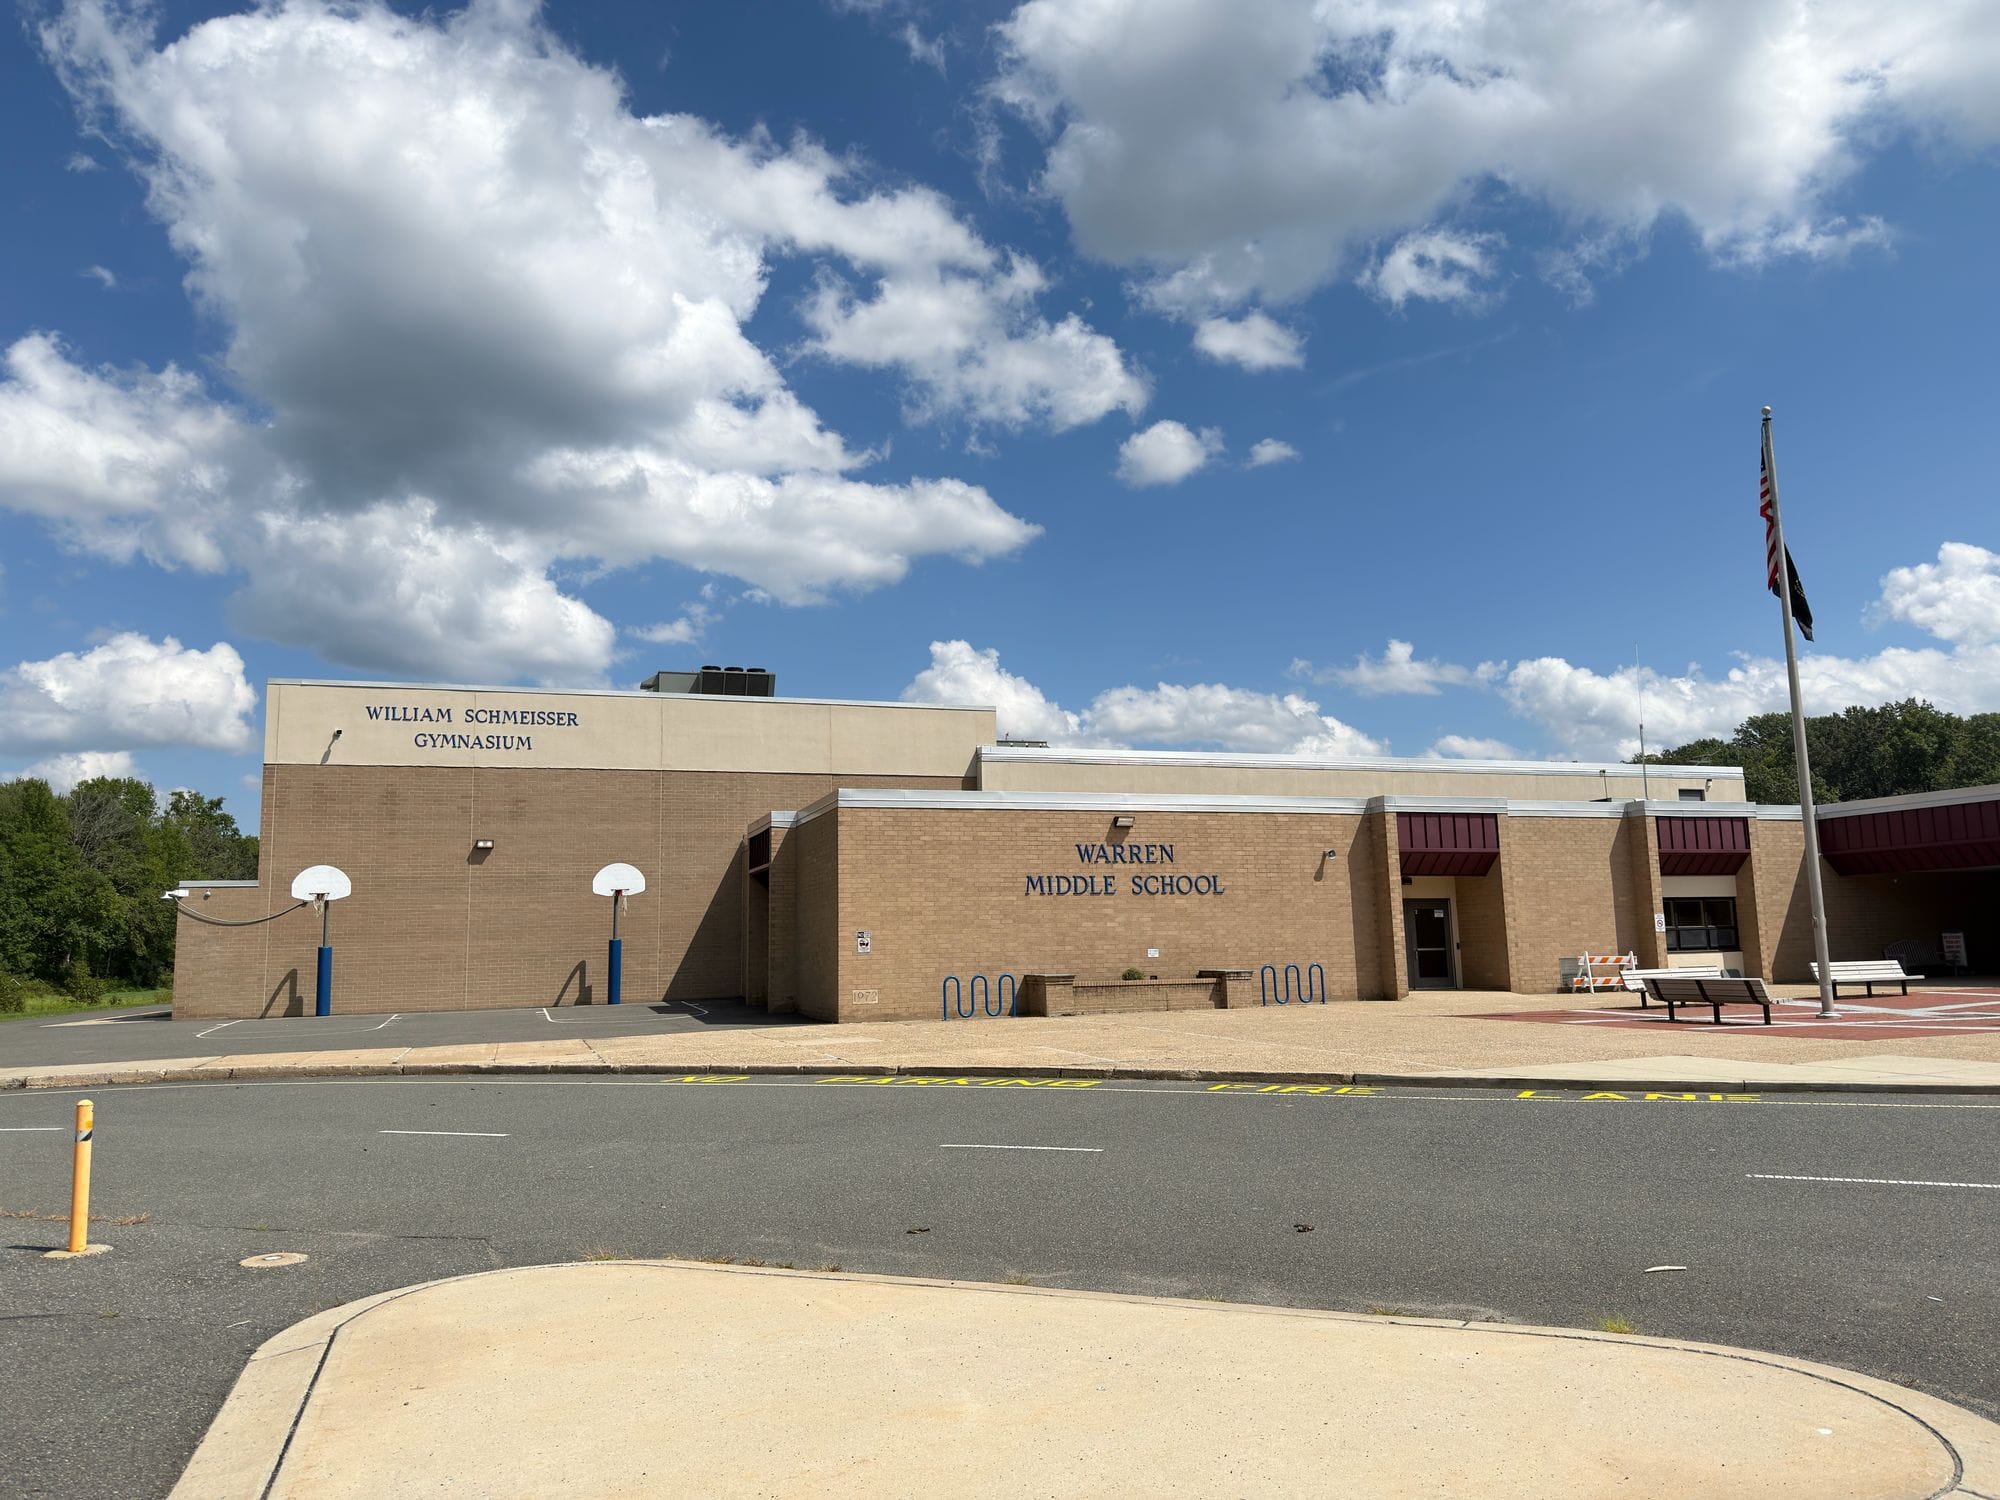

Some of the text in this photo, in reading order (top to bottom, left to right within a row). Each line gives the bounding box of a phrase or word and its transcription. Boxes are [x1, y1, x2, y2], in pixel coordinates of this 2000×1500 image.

[366, 706, 579, 726] WILLIAM SCHMEISSER
[414, 733, 532, 750] GYMNASIUM
[1075, 843, 1175, 864] WARREN
[1024, 875, 1225, 896] MIDDLE SCHOOL
[660, 1075, 1102, 1087] NO PARKING
[1207, 1084, 1762, 1101] FIRE LANE
